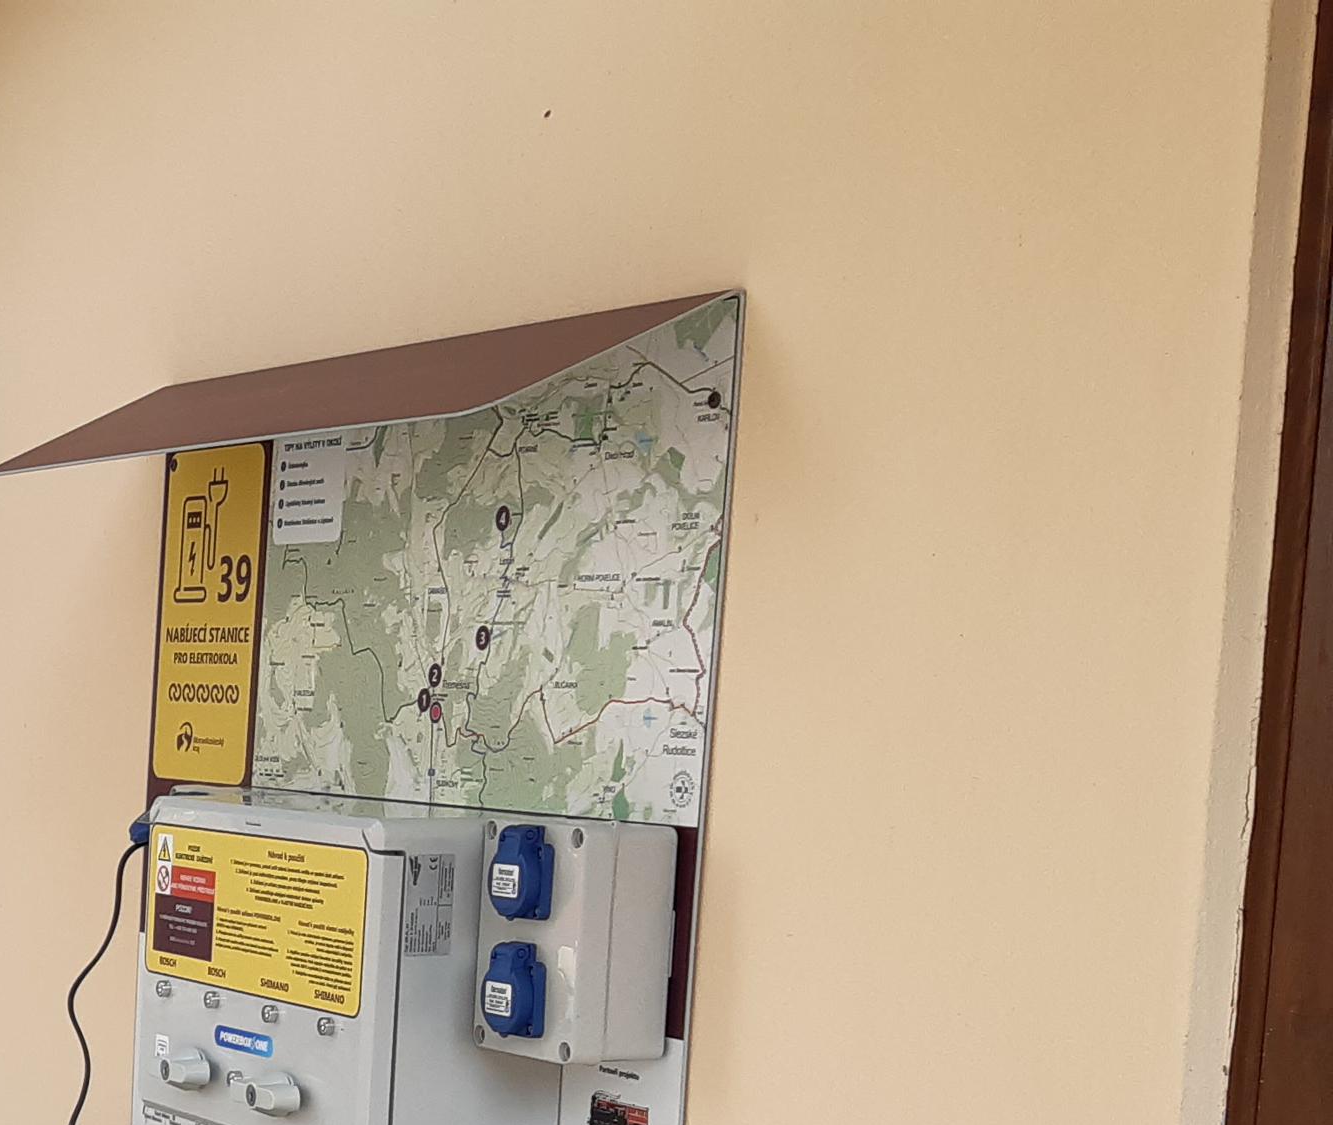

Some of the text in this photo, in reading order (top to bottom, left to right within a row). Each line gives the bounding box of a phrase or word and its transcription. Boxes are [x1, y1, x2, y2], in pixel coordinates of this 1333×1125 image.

[499, 511, 507, 526] 4
[217, 554, 252, 602] 39
[165, 623, 250, 644] NABÍJECÍ STANICE
[479, 630, 486, 645] 3
[173, 652, 238, 665] PRO ELEKTROKOLA
[431, 668, 438, 683] 2
[421, 693, 428, 706] 1
[159, 956, 177, 967] BOSCH
[207, 966, 226, 978] BOSCH
[260, 977, 289, 993] SHIMANO
[314, 989, 345, 1004] SHIMANO
